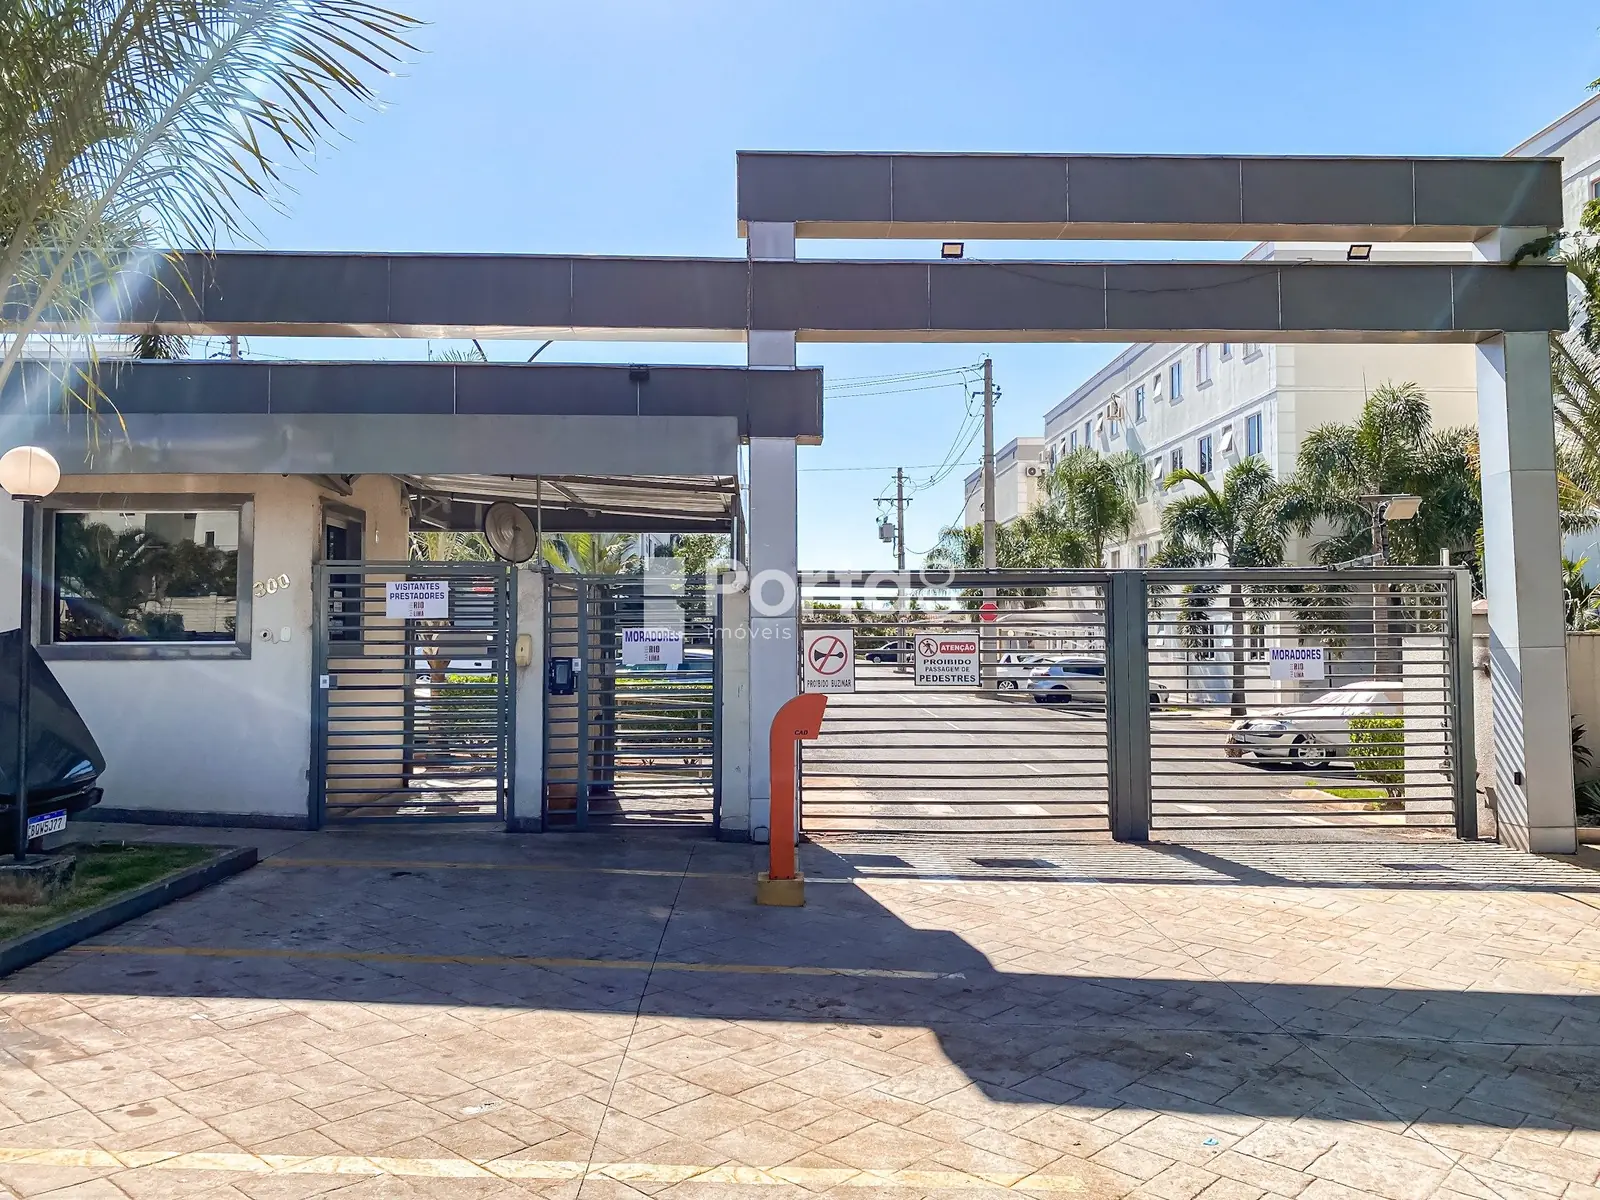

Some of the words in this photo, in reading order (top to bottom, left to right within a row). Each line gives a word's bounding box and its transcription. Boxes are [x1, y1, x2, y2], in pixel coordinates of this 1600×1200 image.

[253, 573, 290, 598] 300
[389, 592, 445, 600] PRESTADORES
[413, 601, 424, 609] RIO
[625, 631, 680, 642] MORADORES
[648, 645, 660, 653] RIO
[941, 643, 975, 652] ATENÇÃO
[1272, 649, 1321, 660] MORADORES
[919, 674, 976, 682] PEDESTRES
[831, 679, 851, 687] BUZINAR
